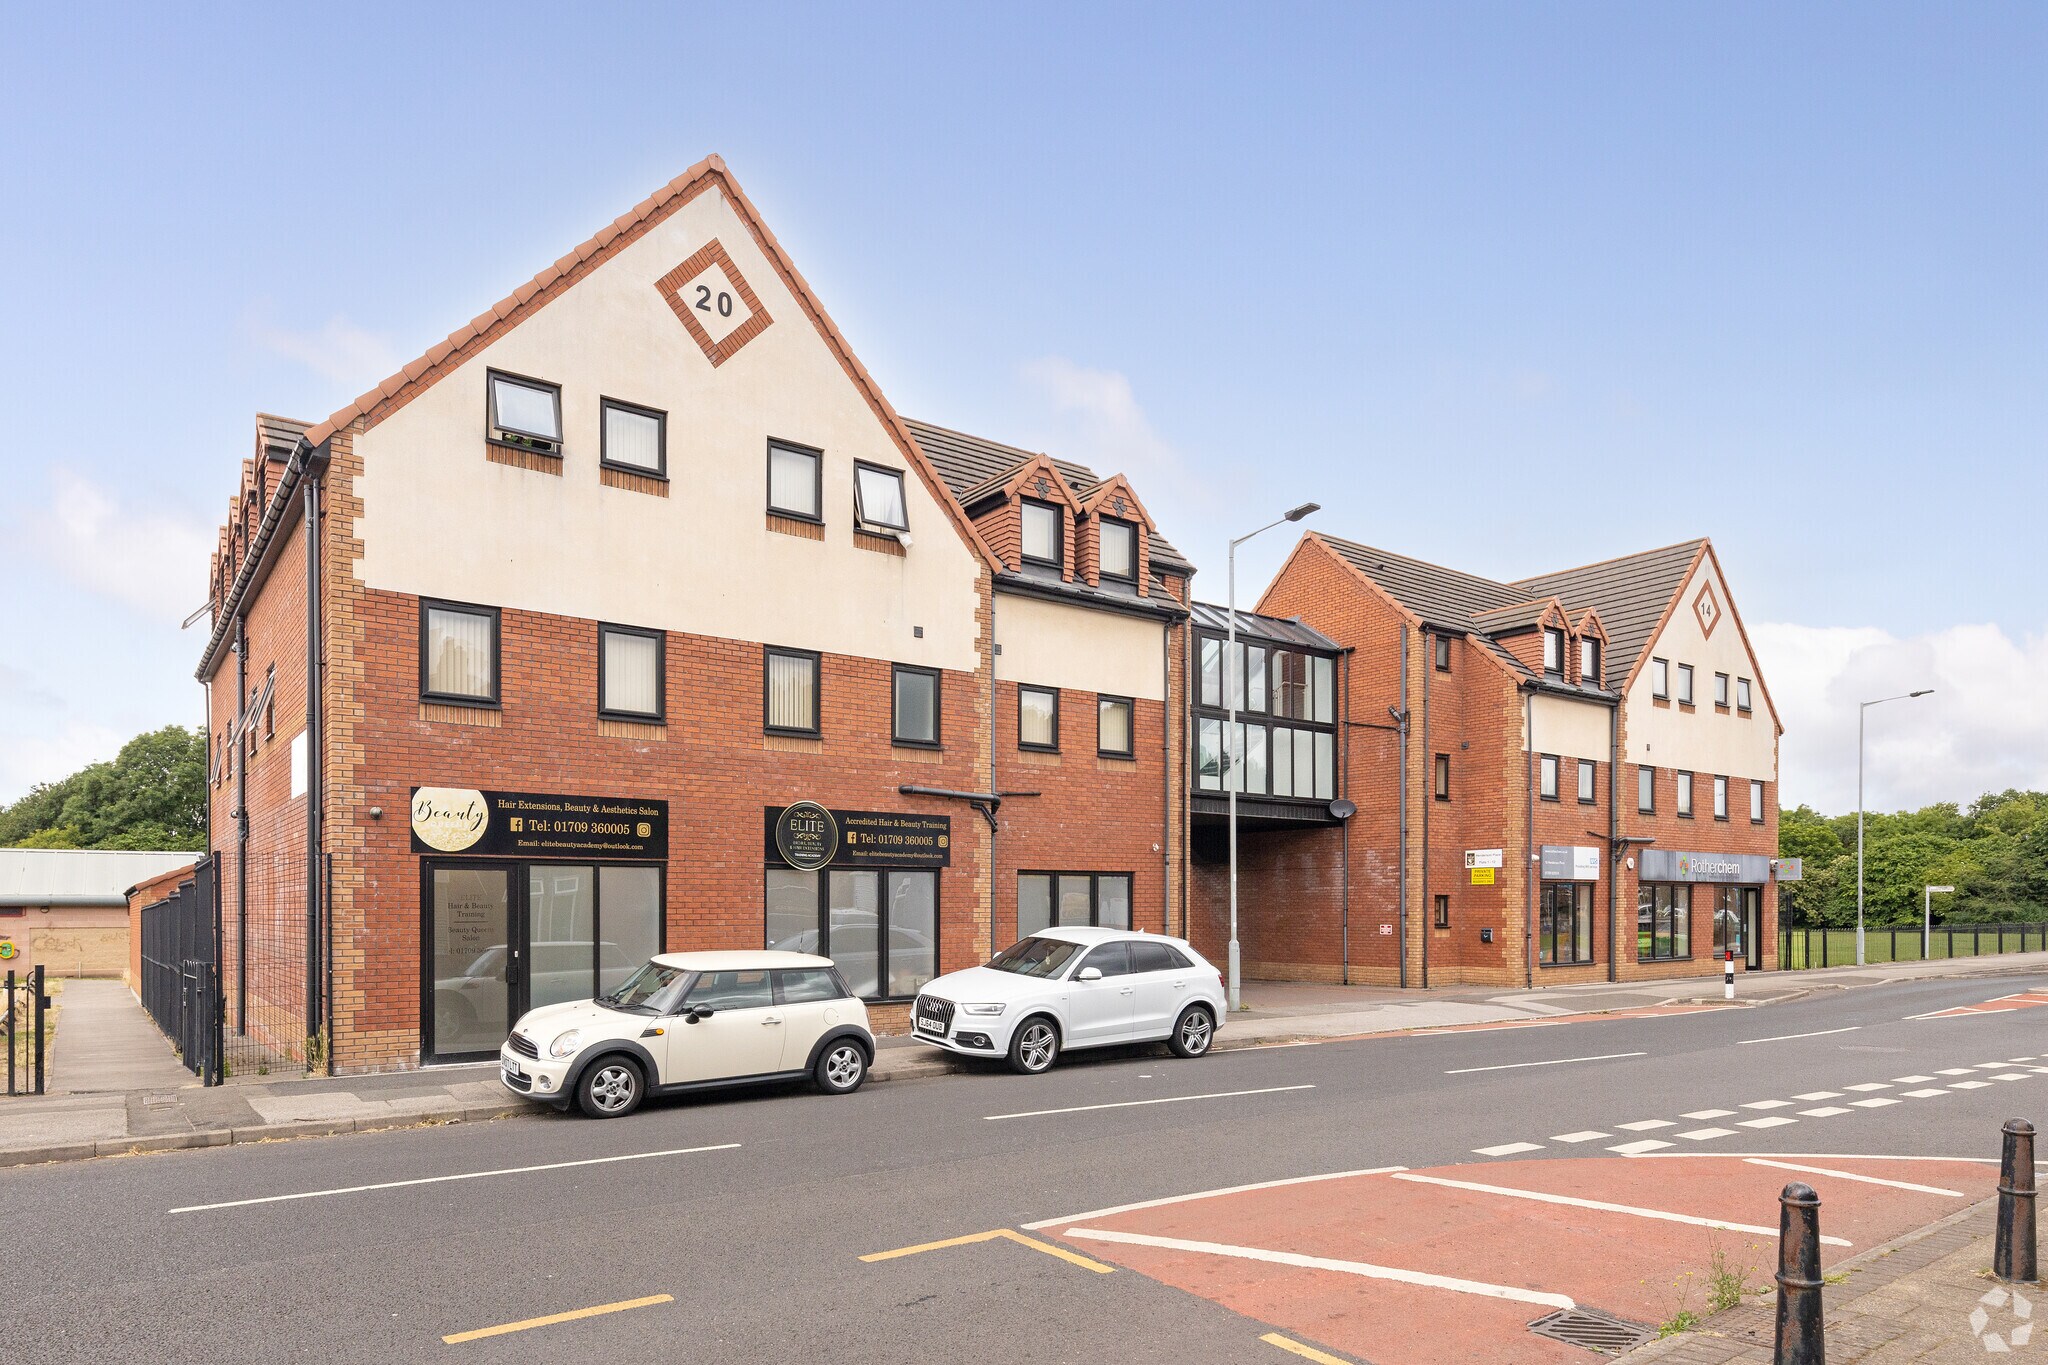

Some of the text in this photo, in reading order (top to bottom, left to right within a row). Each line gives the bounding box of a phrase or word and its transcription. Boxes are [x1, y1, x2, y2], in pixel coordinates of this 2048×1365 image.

[695, 284, 733, 318] 20
[1701, 603, 1711, 617] 14
[497, 799, 659, 816] Hair Extensions, Beauty & Aesthetics Salon
[413, 799, 488, 832] Beauty
[528, 819, 630, 835] Tel: 01709 360005
[790, 818, 825, 833] ELITE
[845, 817, 947, 831] Accredited Hair & Beauty Training
[518, 839, 644, 851] Email: elitebeautyacademy@outlook.com
[860, 833, 934, 846] Tel: 01709 360005
[1691, 858, 1740, 874] Rotherchem
[472, 902, 493, 911] Beauty
